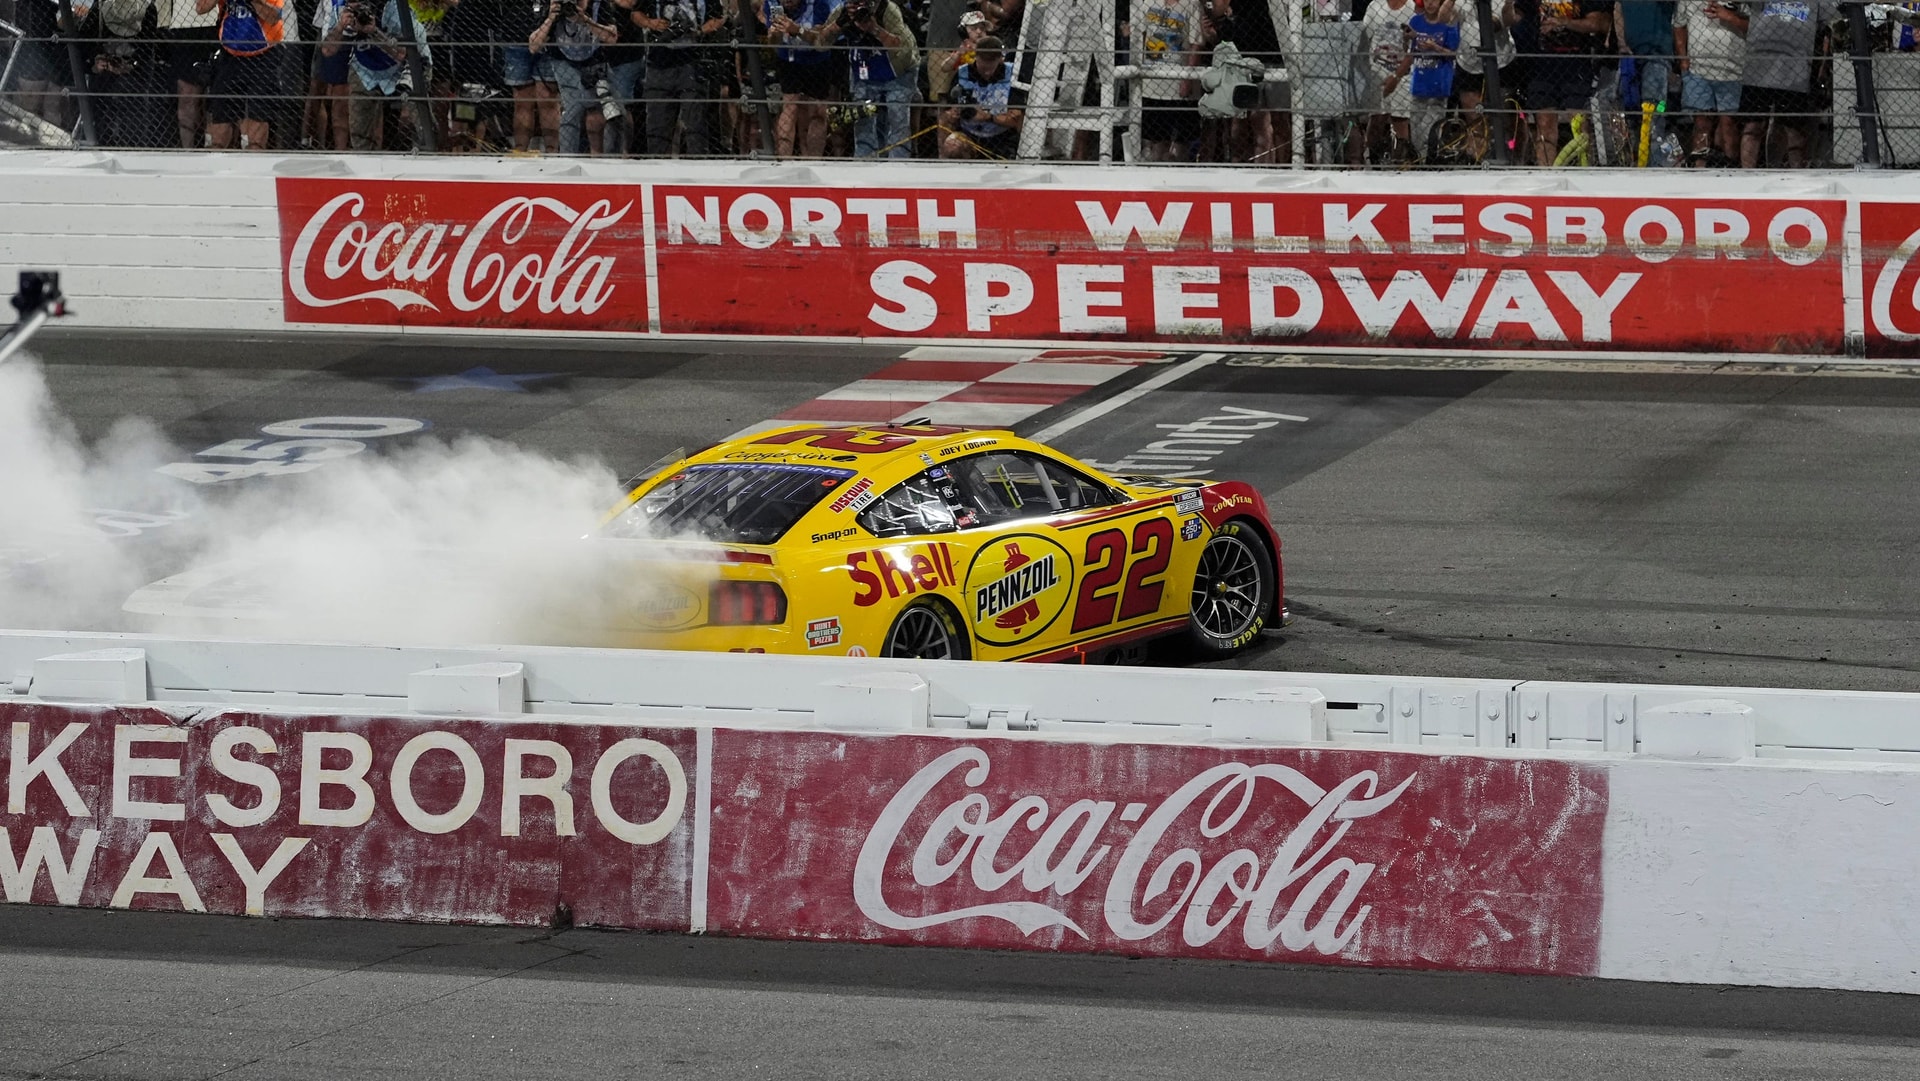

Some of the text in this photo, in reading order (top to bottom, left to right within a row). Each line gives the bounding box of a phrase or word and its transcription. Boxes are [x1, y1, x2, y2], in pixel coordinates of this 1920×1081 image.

[289, 192, 634, 315] Coca-Cola
[664, 192, 1829, 266] NORTH WILKESBORO
[867, 259, 1643, 343] SPEEDWAY
[155, 416, 425, 483] 450
[724, 451, 831, 461] Capgemini
[759, 465, 847, 475] RACING
[939, 445, 962, 457] JOEY
[1078, 406, 1310, 479] finity
[829, 477, 874, 514] DISCOUNT
[851, 492, 872, 511] TIRE
[811, 527, 857, 544] Snap-on
[1185, 524, 1198, 535] 250
[846, 542, 956, 607] Shell
[976, 554, 1058, 623] PENNZOIL
[1070, 517, 1174, 635] 22
[814, 635, 833, 645] PIZZA
[1232, 616, 1264, 648] EAGLE
[5, 721, 688, 845] KESBORO
[0, 825, 311, 917] WAY
[853, 746, 1416, 956] Coca-Cola
